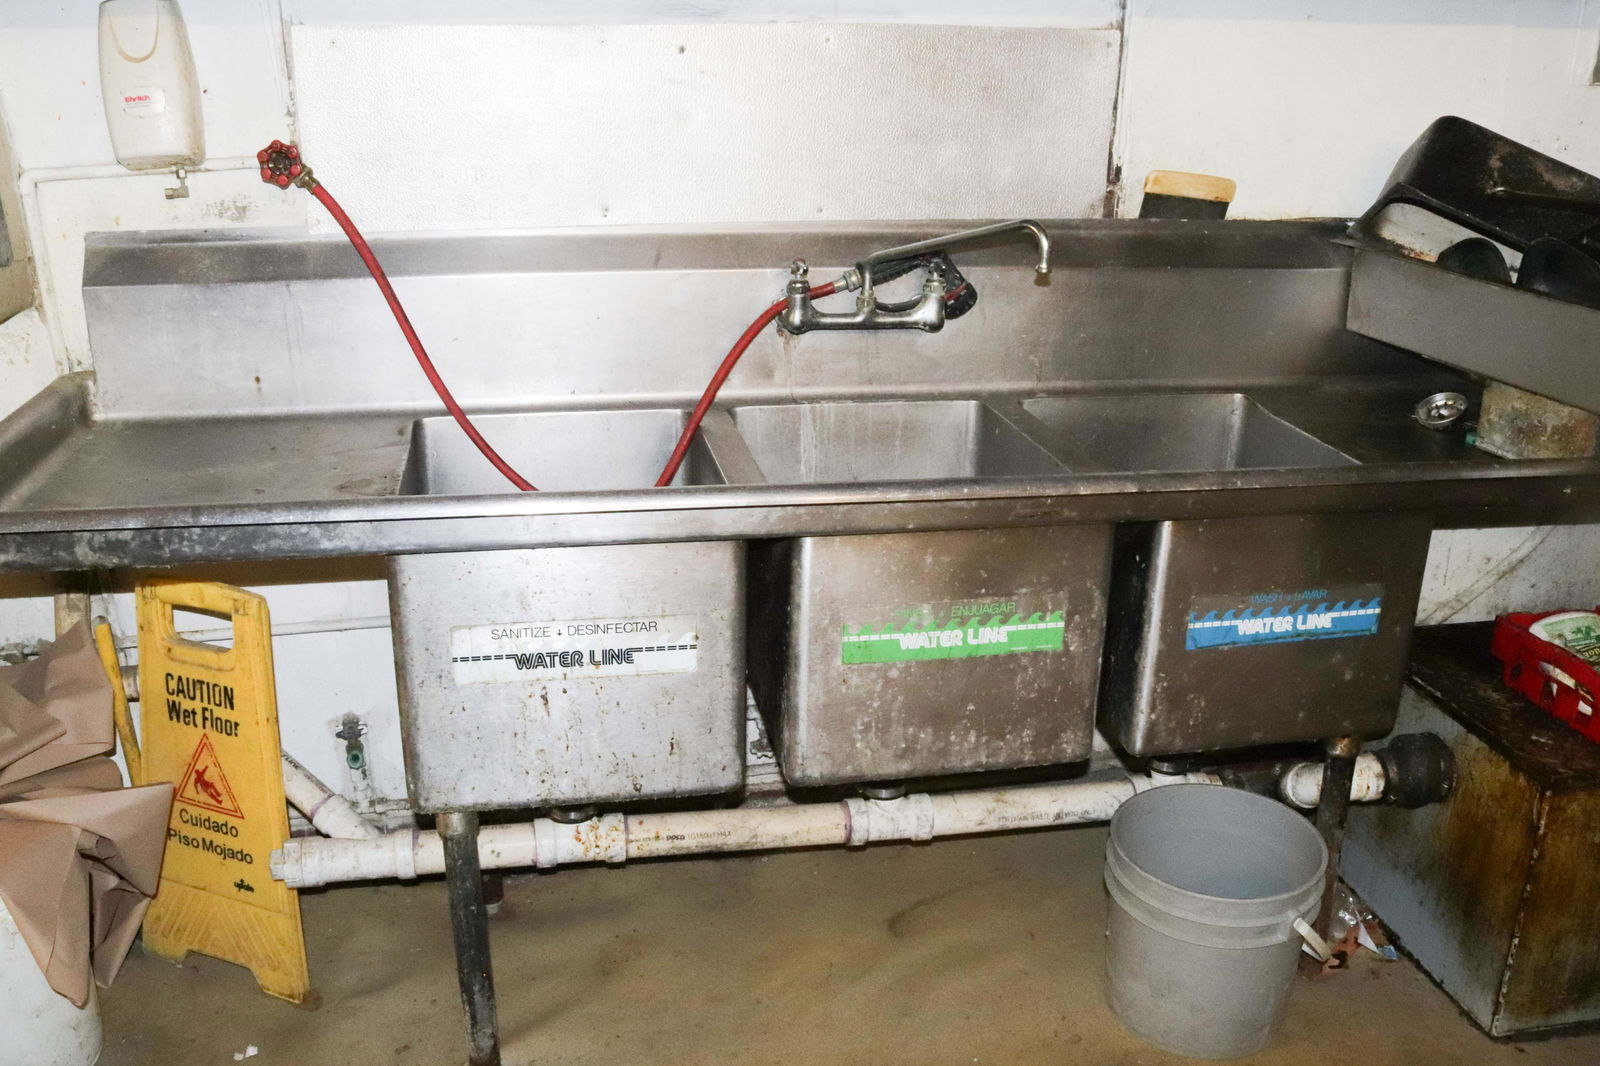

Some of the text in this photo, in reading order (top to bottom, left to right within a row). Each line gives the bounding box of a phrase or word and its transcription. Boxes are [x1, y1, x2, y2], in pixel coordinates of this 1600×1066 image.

[951, 602, 1016, 617] ENJUAGAR
[491, 621, 658, 641] SANITIZE DESINFECTAR
[1238, 613, 1333, 635] WATER LINE
[899, 627, 1008, 650] WATER LINE
[513, 648, 635, 671] WATER LINE
[165, 672, 235, 711] CAUTION
[166, 698, 240, 738] Wet Floor
[180, 808, 239, 838] Cuidado
[166, 827, 254, 865] Piso Mojado
